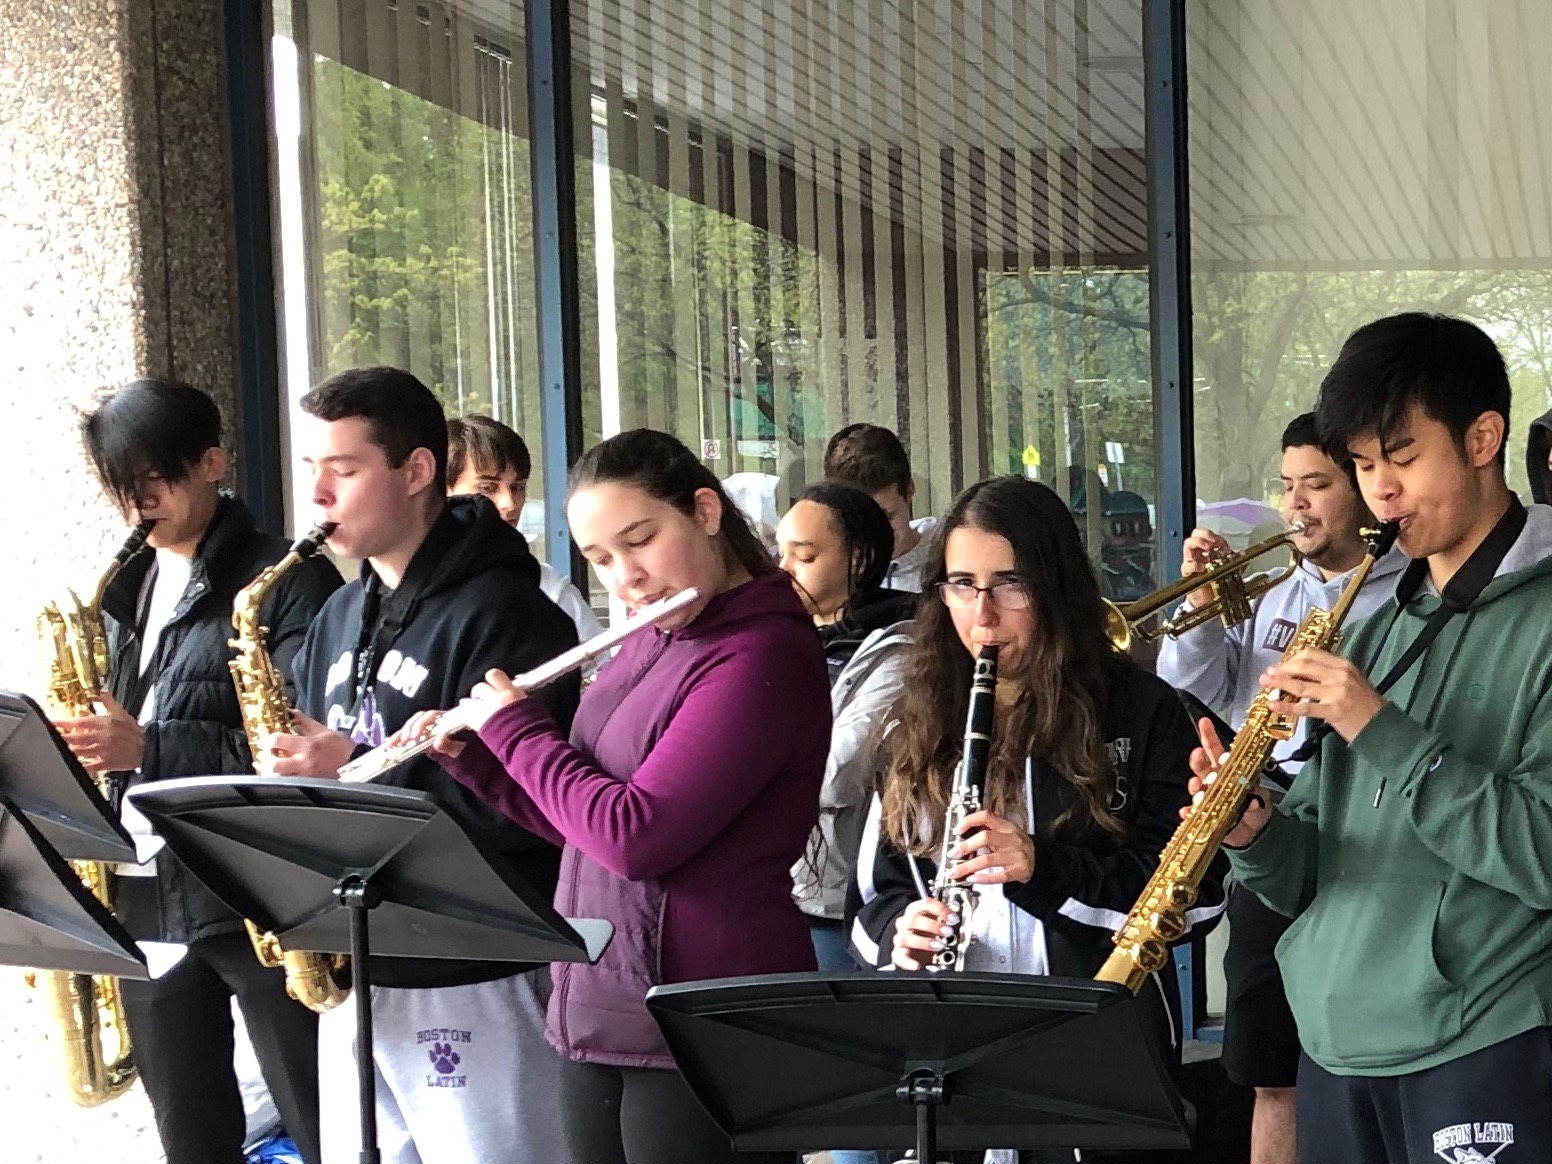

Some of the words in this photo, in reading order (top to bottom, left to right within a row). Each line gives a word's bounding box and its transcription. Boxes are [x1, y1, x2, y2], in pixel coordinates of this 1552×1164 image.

[416, 1028, 472, 1044] BOSTON
[426, 1075, 467, 1088] LATIN
[1473, 1122, 1514, 1144] LATIN
